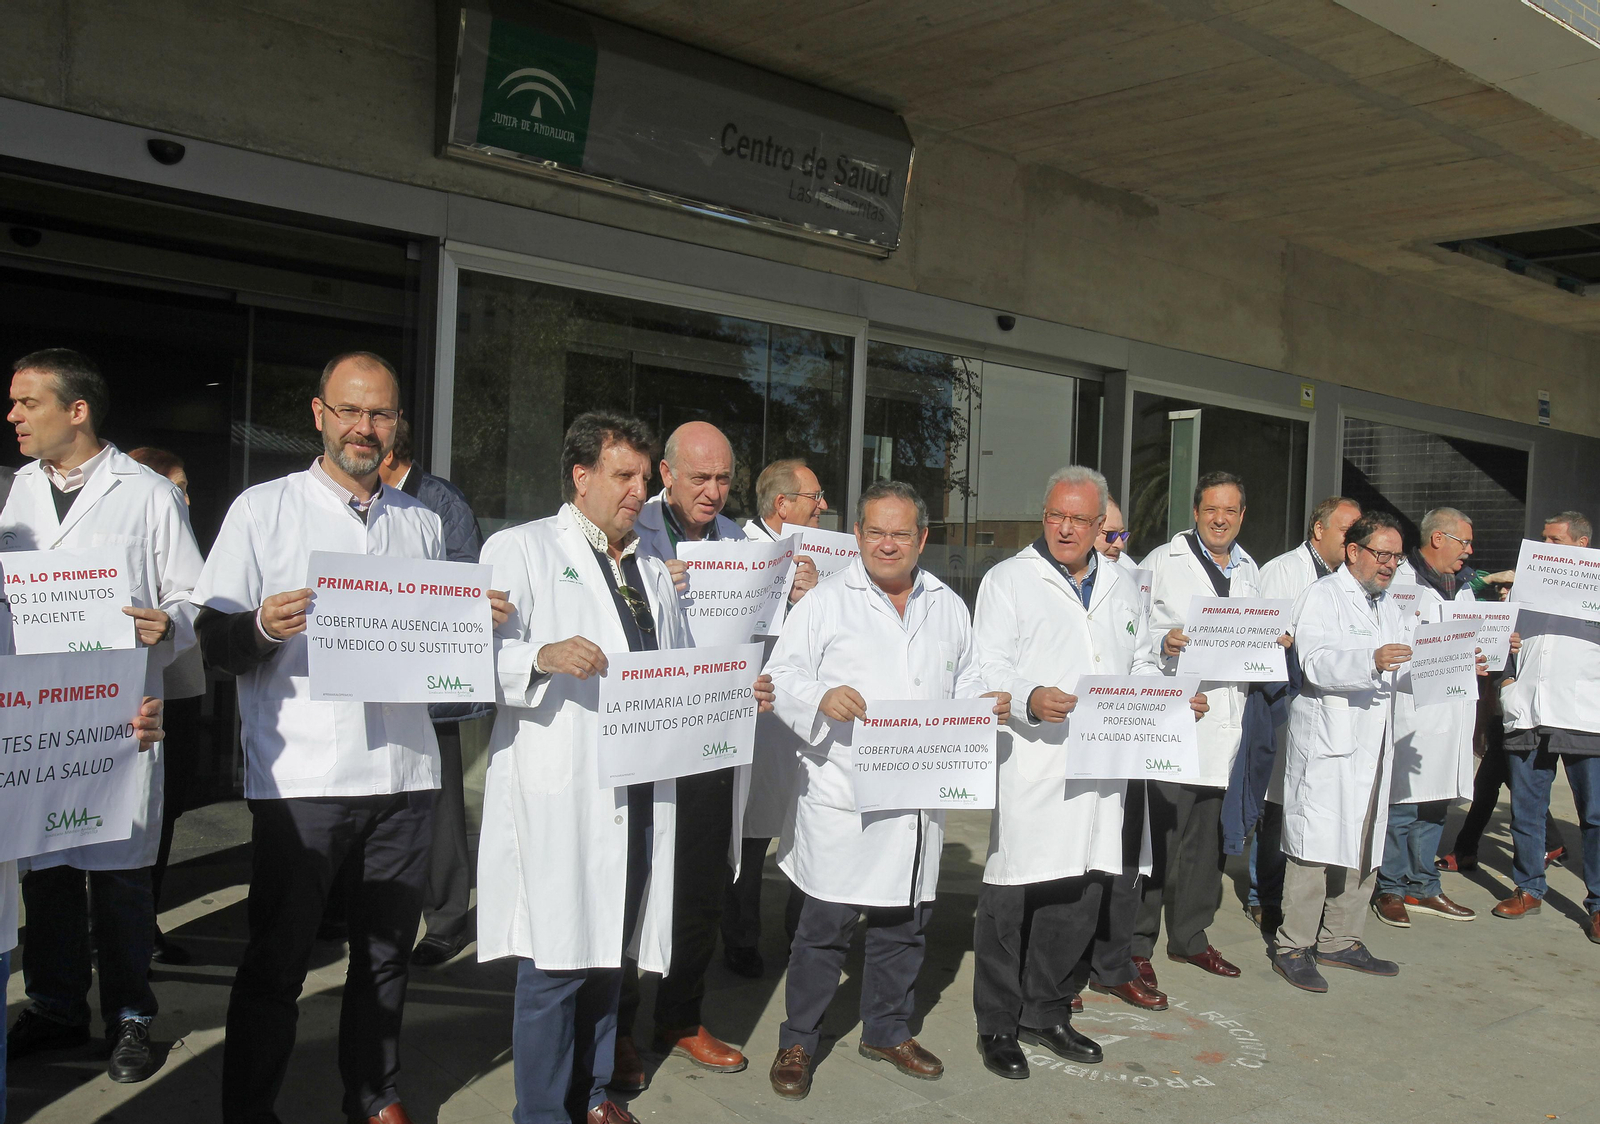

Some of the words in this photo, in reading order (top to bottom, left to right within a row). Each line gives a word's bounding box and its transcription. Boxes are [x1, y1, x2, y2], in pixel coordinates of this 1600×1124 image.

[492, 113, 518, 128] JUNTA
[521, 120, 531, 131] DE
[533, 123, 574, 142] ANDALUCIA
[721, 123, 794, 171] Centro
[802, 147, 827, 180] de
[834, 154, 892, 197] Salud
[789, 179, 812, 204] Las
[687, 561, 748, 572] PRIMARIA,
[752, 562, 765, 570] LO
[1532, 554, 1576, 566] PRIMARIA,
[4, 574, 25, 585] IA,
[30, 573, 48, 582] LO
[53, 568, 118, 581] PRIMERO
[1538, 566, 1567, 576] MENOS
[317, 577, 393, 595] PRIMARIA,
[398, 582, 416, 594] LO
[420, 584, 481, 598] PRIMERO
[1542, 578, 1559, 586] POR
[1560, 580, 1598, 591] PACIENTE
[32, 592, 47, 603] 10
[51, 588, 115, 602] MINUTOS
[684, 590, 743, 599] COBERTURA
[23, 611, 86, 624] PACIENTE
[700, 608, 738, 616] MEDICO
[741, 607, 747, 615] O
[316, 615, 388, 630] COBERTURA
[391, 619, 449, 632] AUSENCIA
[452, 622, 484, 633] 100%
[1247, 628, 1281, 636] PRIMERO,
[1452, 632, 1475, 640] PRIMERO
[337, 639, 384, 651] MEDICO
[388, 640, 397, 652] O
[401, 641, 416, 652] SU
[1194, 639, 1228, 648] MINUTOS
[622, 666, 689, 681] PRIMARIA,
[693, 660, 747, 675] PRIMERO
[1244, 662, 1272, 671] SMA
[427, 675, 471, 690] SMA
[39, 683, 119, 704] PRIMERO
[1088, 687, 1138, 696] PRIMARIA,
[1140, 688, 1183, 697] PRIMERO
[606, 702, 621, 714] LA
[625, 696, 683, 712] PRIMARIA
[687, 694, 701, 706] LO
[705, 687, 754, 703] PRIMERO,
[1097, 702, 1114, 710] POR
[1116, 702, 1125, 710] LA
[1128, 702, 1166, 712] DIGNIDAD
[602, 724, 617, 736] 10
[622, 718, 677, 734] MINUTOS
[681, 715, 704, 728] POR
[707, 707, 754, 724] PACIENTE
[864, 718, 921, 728] PRIMARIA,
[925, 717, 939, 726] LO
[942, 716, 991, 725] PRIMERO
[1103, 717, 1156, 726] PROFESIONAL
[2, 735, 32, 754] TES
[38, 732, 60, 750] EN
[66, 723, 134, 746] SANIDAD
[1080, 733, 1085, 741] Y
[1087, 733, 1096, 741] LA
[1098, 733, 1131, 742] CALIDAD
[1134, 733, 1181, 742] ASITENCIAL
[703, 741, 736, 756] SMA
[858, 745, 914, 755] COBERTURA
[916, 744, 961, 754] AUSENCIA
[964, 744, 988, 753] 100%
[36, 766, 55, 783] LA
[61, 758, 114, 780] SALUD
[872, 762, 909, 771] MEDICO
[912, 762, 918, 770] O
[921, 761, 933, 770] SU
[1146, 759, 1179, 770] SMA
[939, 787, 975, 799] SMA
[46, 807, 101, 831] SMA
